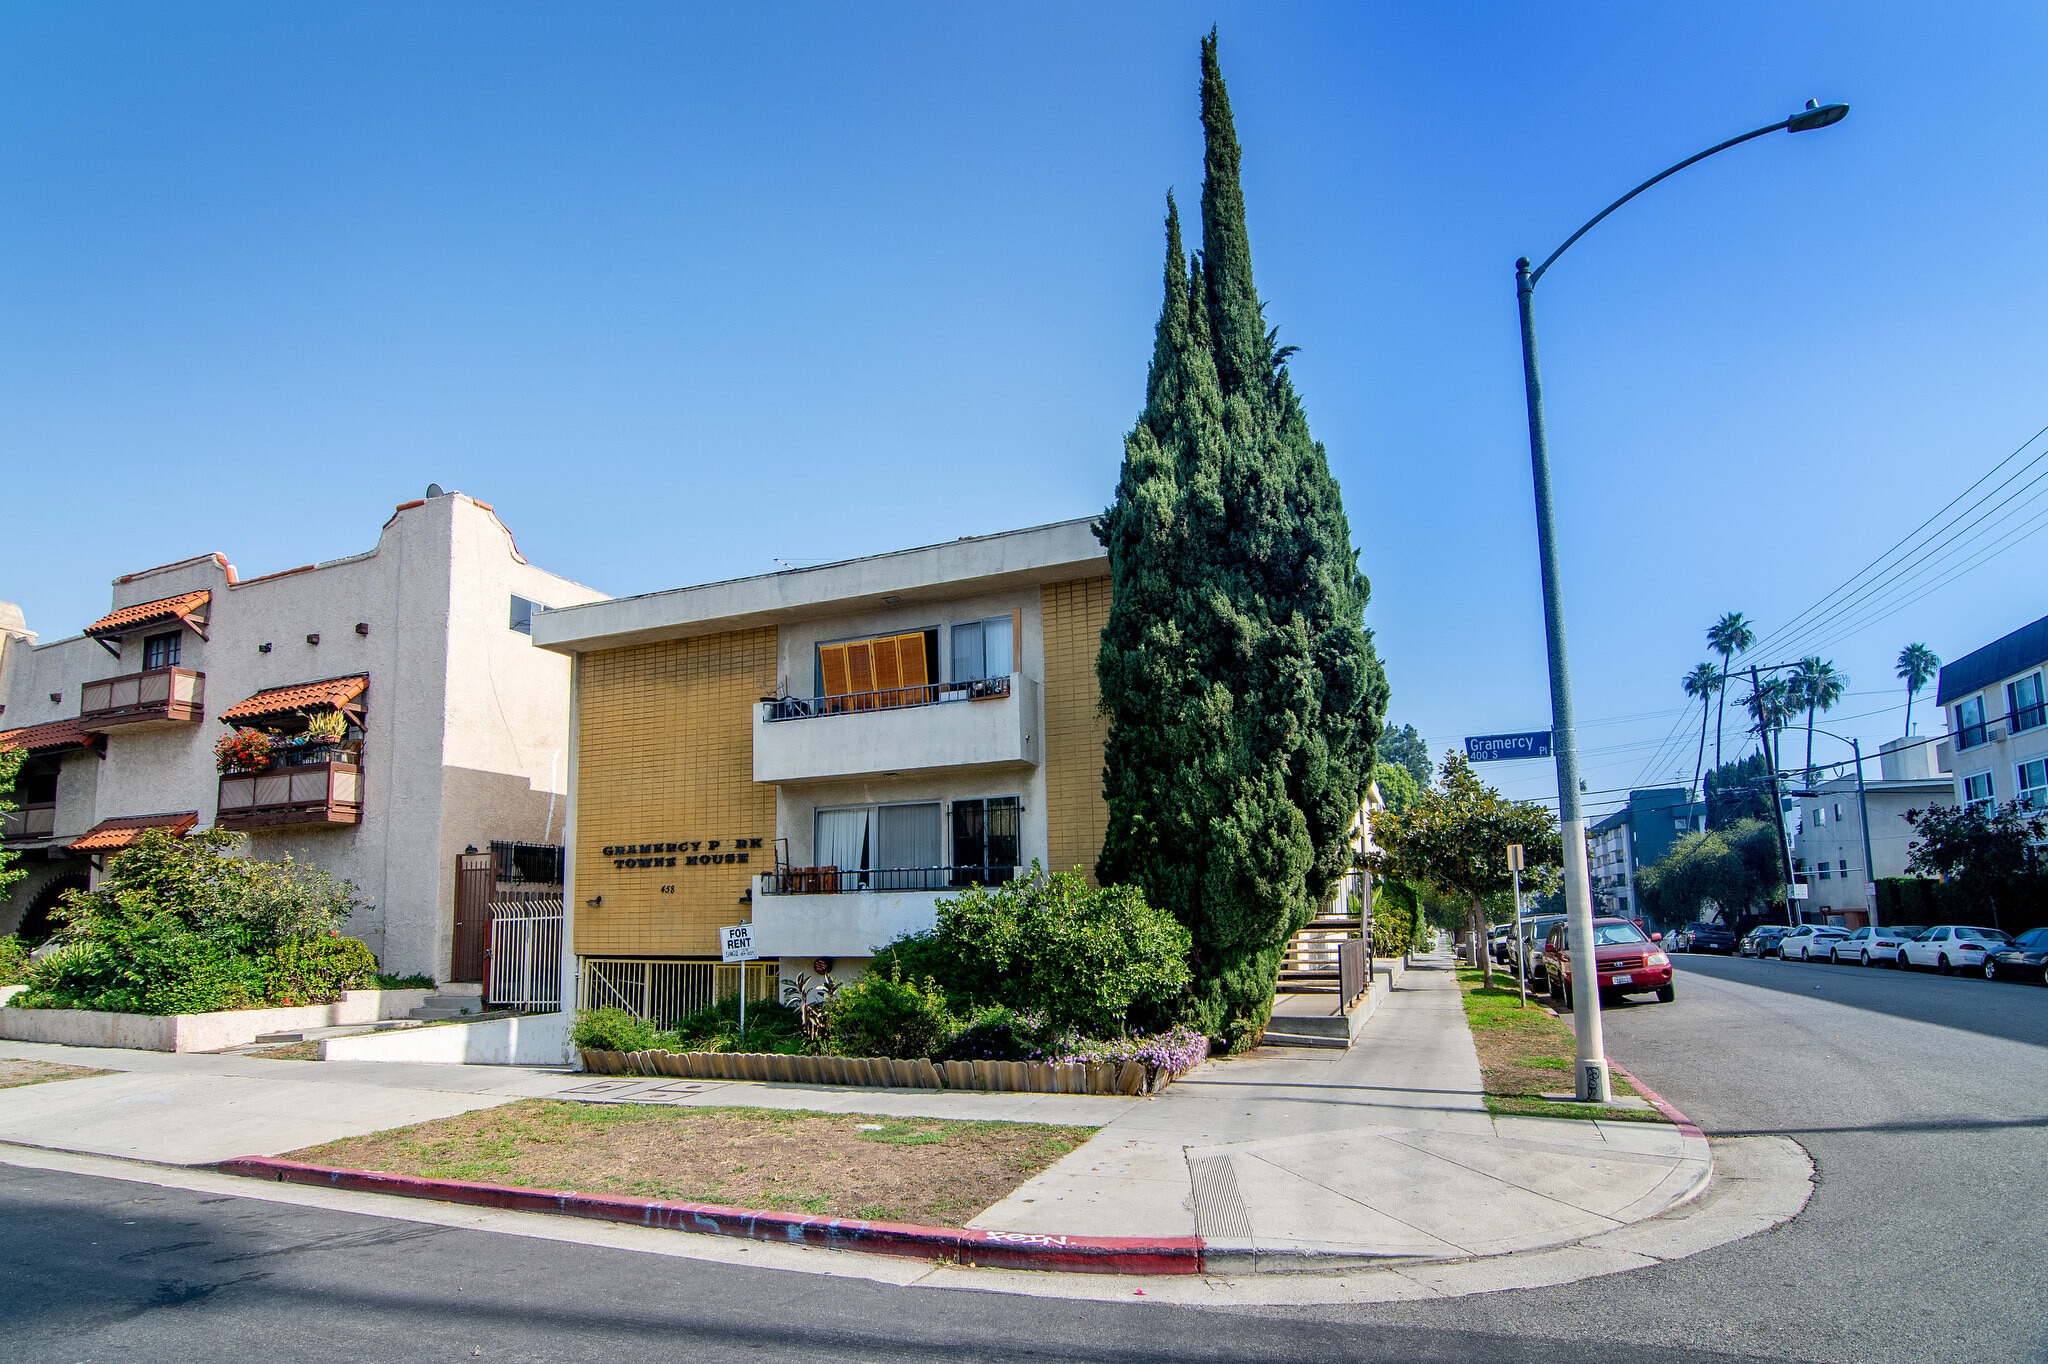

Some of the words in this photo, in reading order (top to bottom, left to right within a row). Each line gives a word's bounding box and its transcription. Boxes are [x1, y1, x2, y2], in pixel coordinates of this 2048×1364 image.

[1470, 737, 1533, 751] Gramercy
[1470, 751, 1488, 760] 400
[1492, 750, 1498, 759] S
[1539, 746, 1548, 755] Pl
[602, 841, 701, 856] GRAMERCY
[614, 857, 676, 869] TOWNE
[685, 853, 749, 865] HOUSE
[660, 885, 675, 894] 458
[729, 928, 747, 938] FOR
[727, 938, 751, 949] RENT
